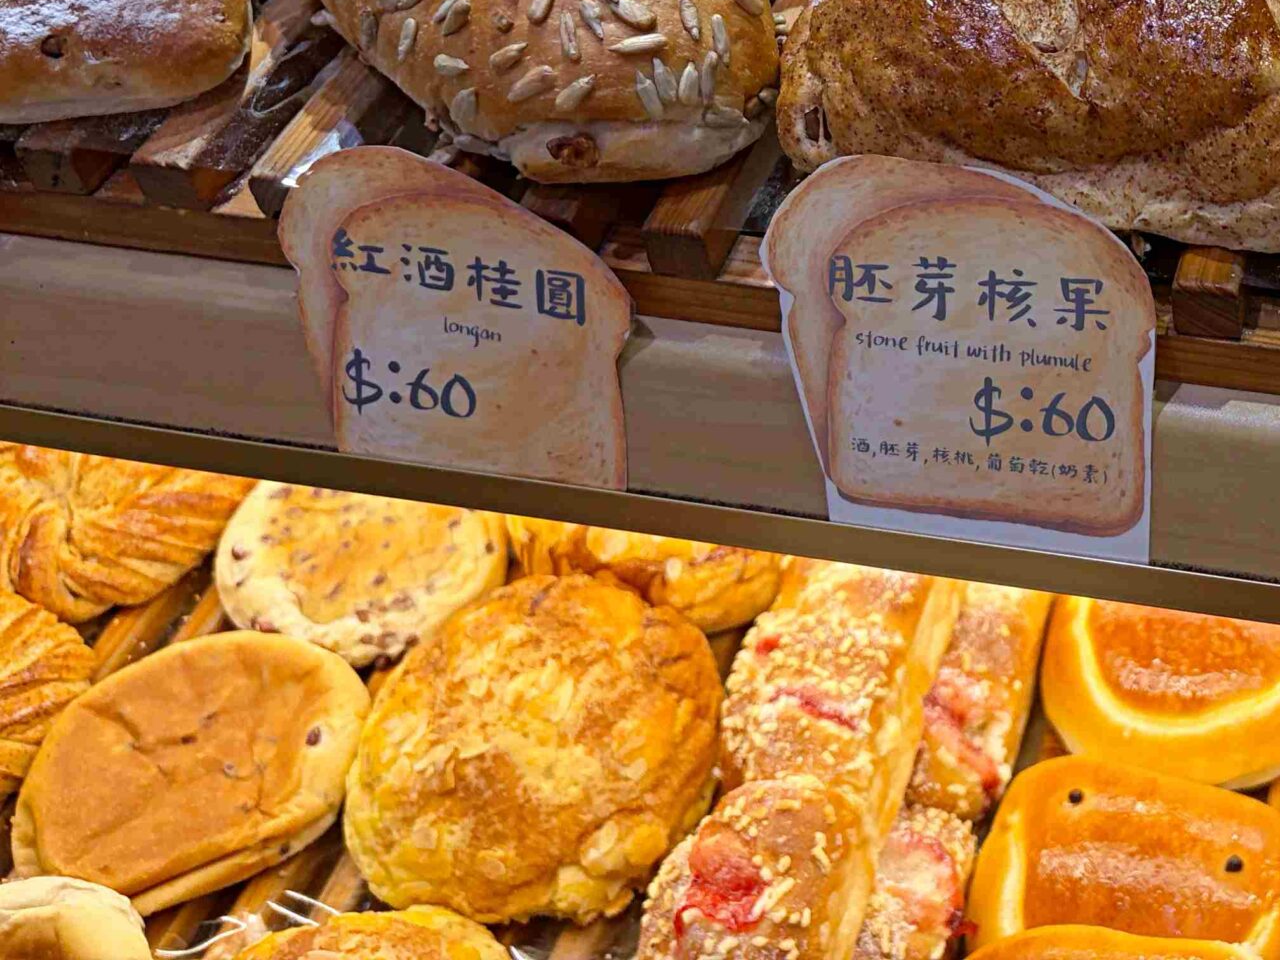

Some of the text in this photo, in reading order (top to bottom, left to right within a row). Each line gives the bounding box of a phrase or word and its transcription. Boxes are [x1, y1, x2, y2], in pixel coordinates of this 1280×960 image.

[331, 227, 586, 327] 紅酒桂圓
[829, 255, 1111, 331] 胚芽核果
[443, 317, 502, 347] longan
[855, 331, 1093, 373] stone fruit with plumule
